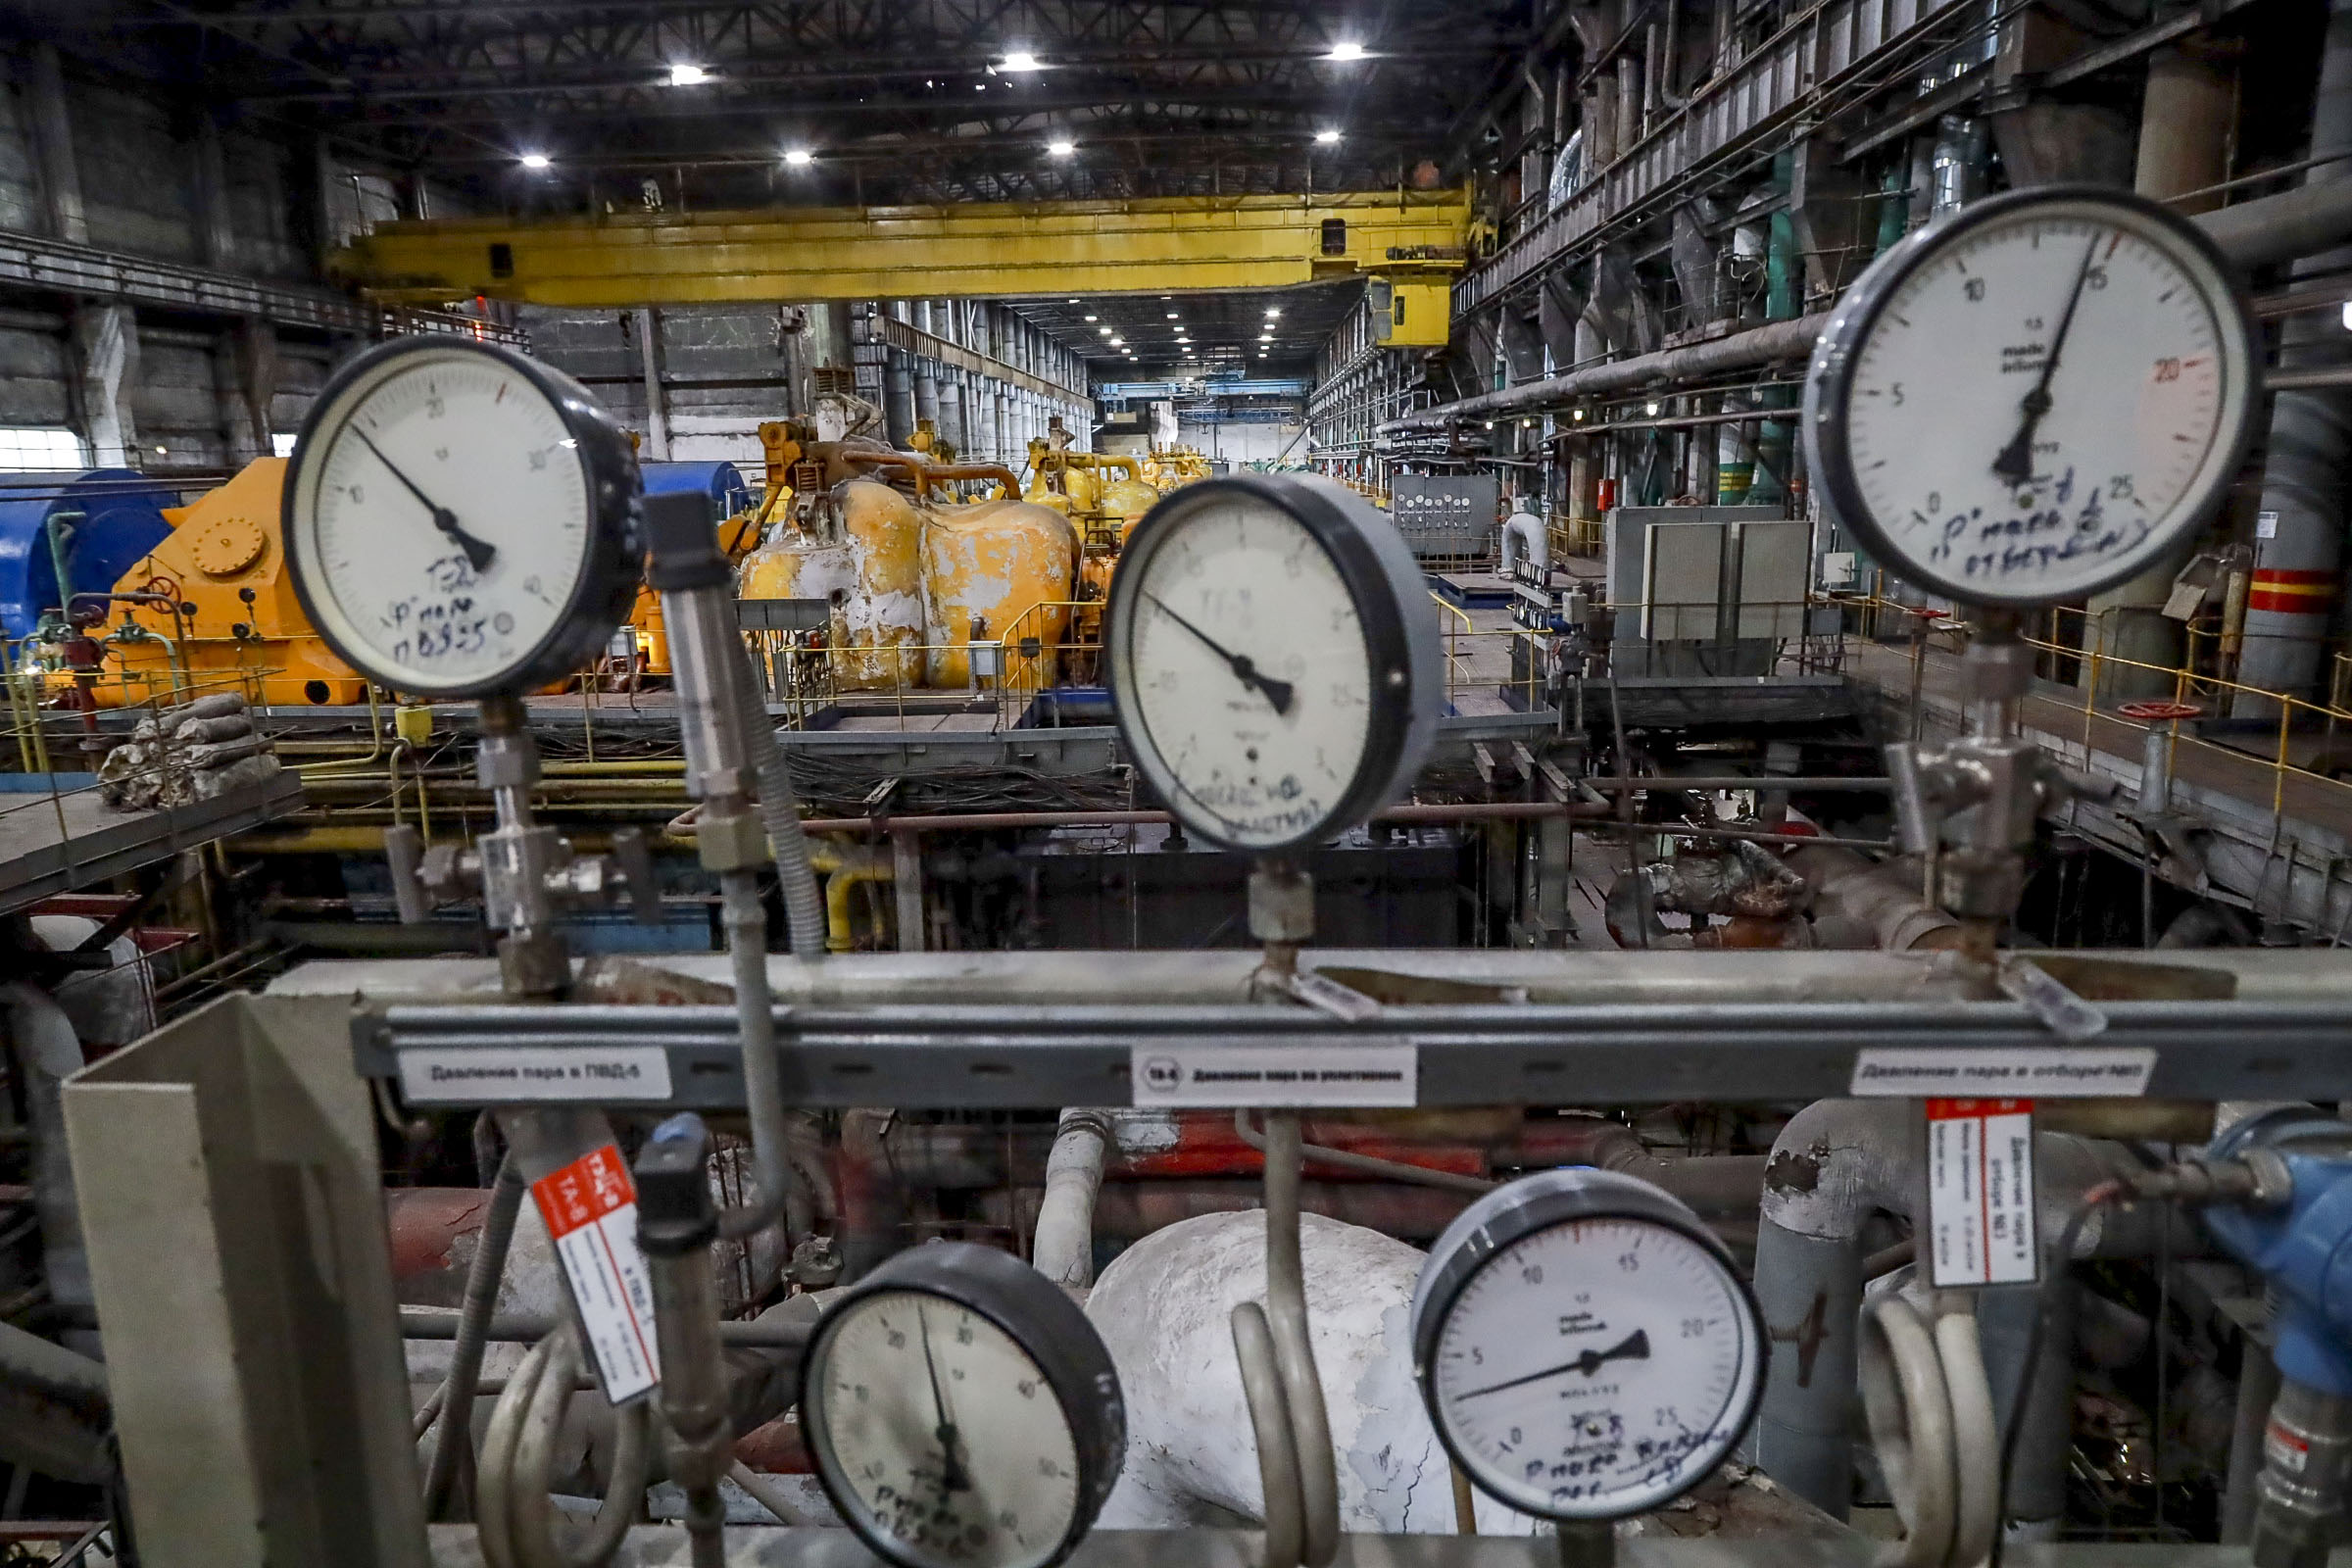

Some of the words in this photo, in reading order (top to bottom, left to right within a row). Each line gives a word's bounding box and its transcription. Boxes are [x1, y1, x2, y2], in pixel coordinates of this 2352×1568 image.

[1964, 278, 1985, 302] 10
[2155, 358, 2180, 383] 20
[1891, 381, 1905, 407] 5
[2110, 475, 2134, 500] 25
[1928, 492, 1941, 515] 0
[1619, 1252, 1640, 1272] 15
[1681, 1317, 1704, 1339] 20
[1472, 1347, 1484, 1366] 5
[1511, 1426, 1523, 1446] 0
